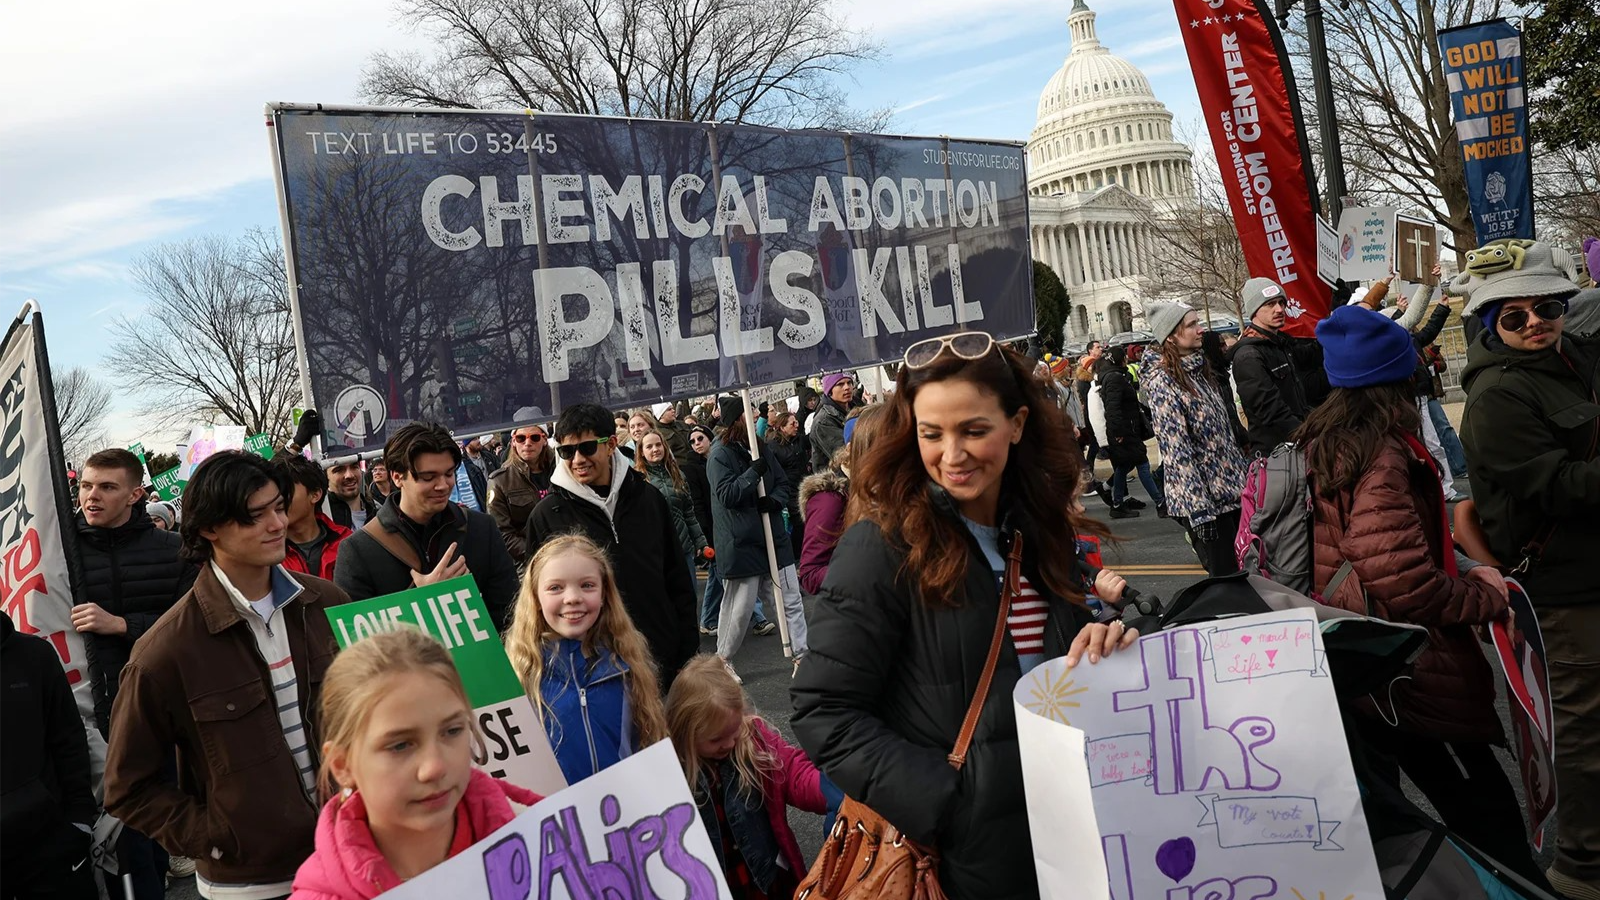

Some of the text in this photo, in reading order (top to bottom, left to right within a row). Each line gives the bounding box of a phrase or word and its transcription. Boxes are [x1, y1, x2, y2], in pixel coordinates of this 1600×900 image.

[1446, 40, 1496, 67] GOD
[1462, 63, 1519, 90] WILL
[1463, 89, 1505, 116] NOT
[1491, 113, 1516, 136] BE
[306, 132, 557, 155] TEXT LIFE TO 53445
[1463, 136, 1524, 162] MOCKED
[922, 148, 1020, 171] STUDENTSFORLIFE.ORG
[1220, 110, 1257, 215] STANDING FOR
[1221, 31, 1298, 285] FREEDOM CENTER
[421, 173, 1000, 251] CHEMICAL ABORTION
[1480, 208, 1520, 224] WHITE
[532, 244, 984, 384] PILLS KILL
[152, 474, 172, 491] LOVE
[411, 588, 490, 649] LIFE
[1113, 628, 1281, 795] the
[1228, 803, 1303, 825] My vote
